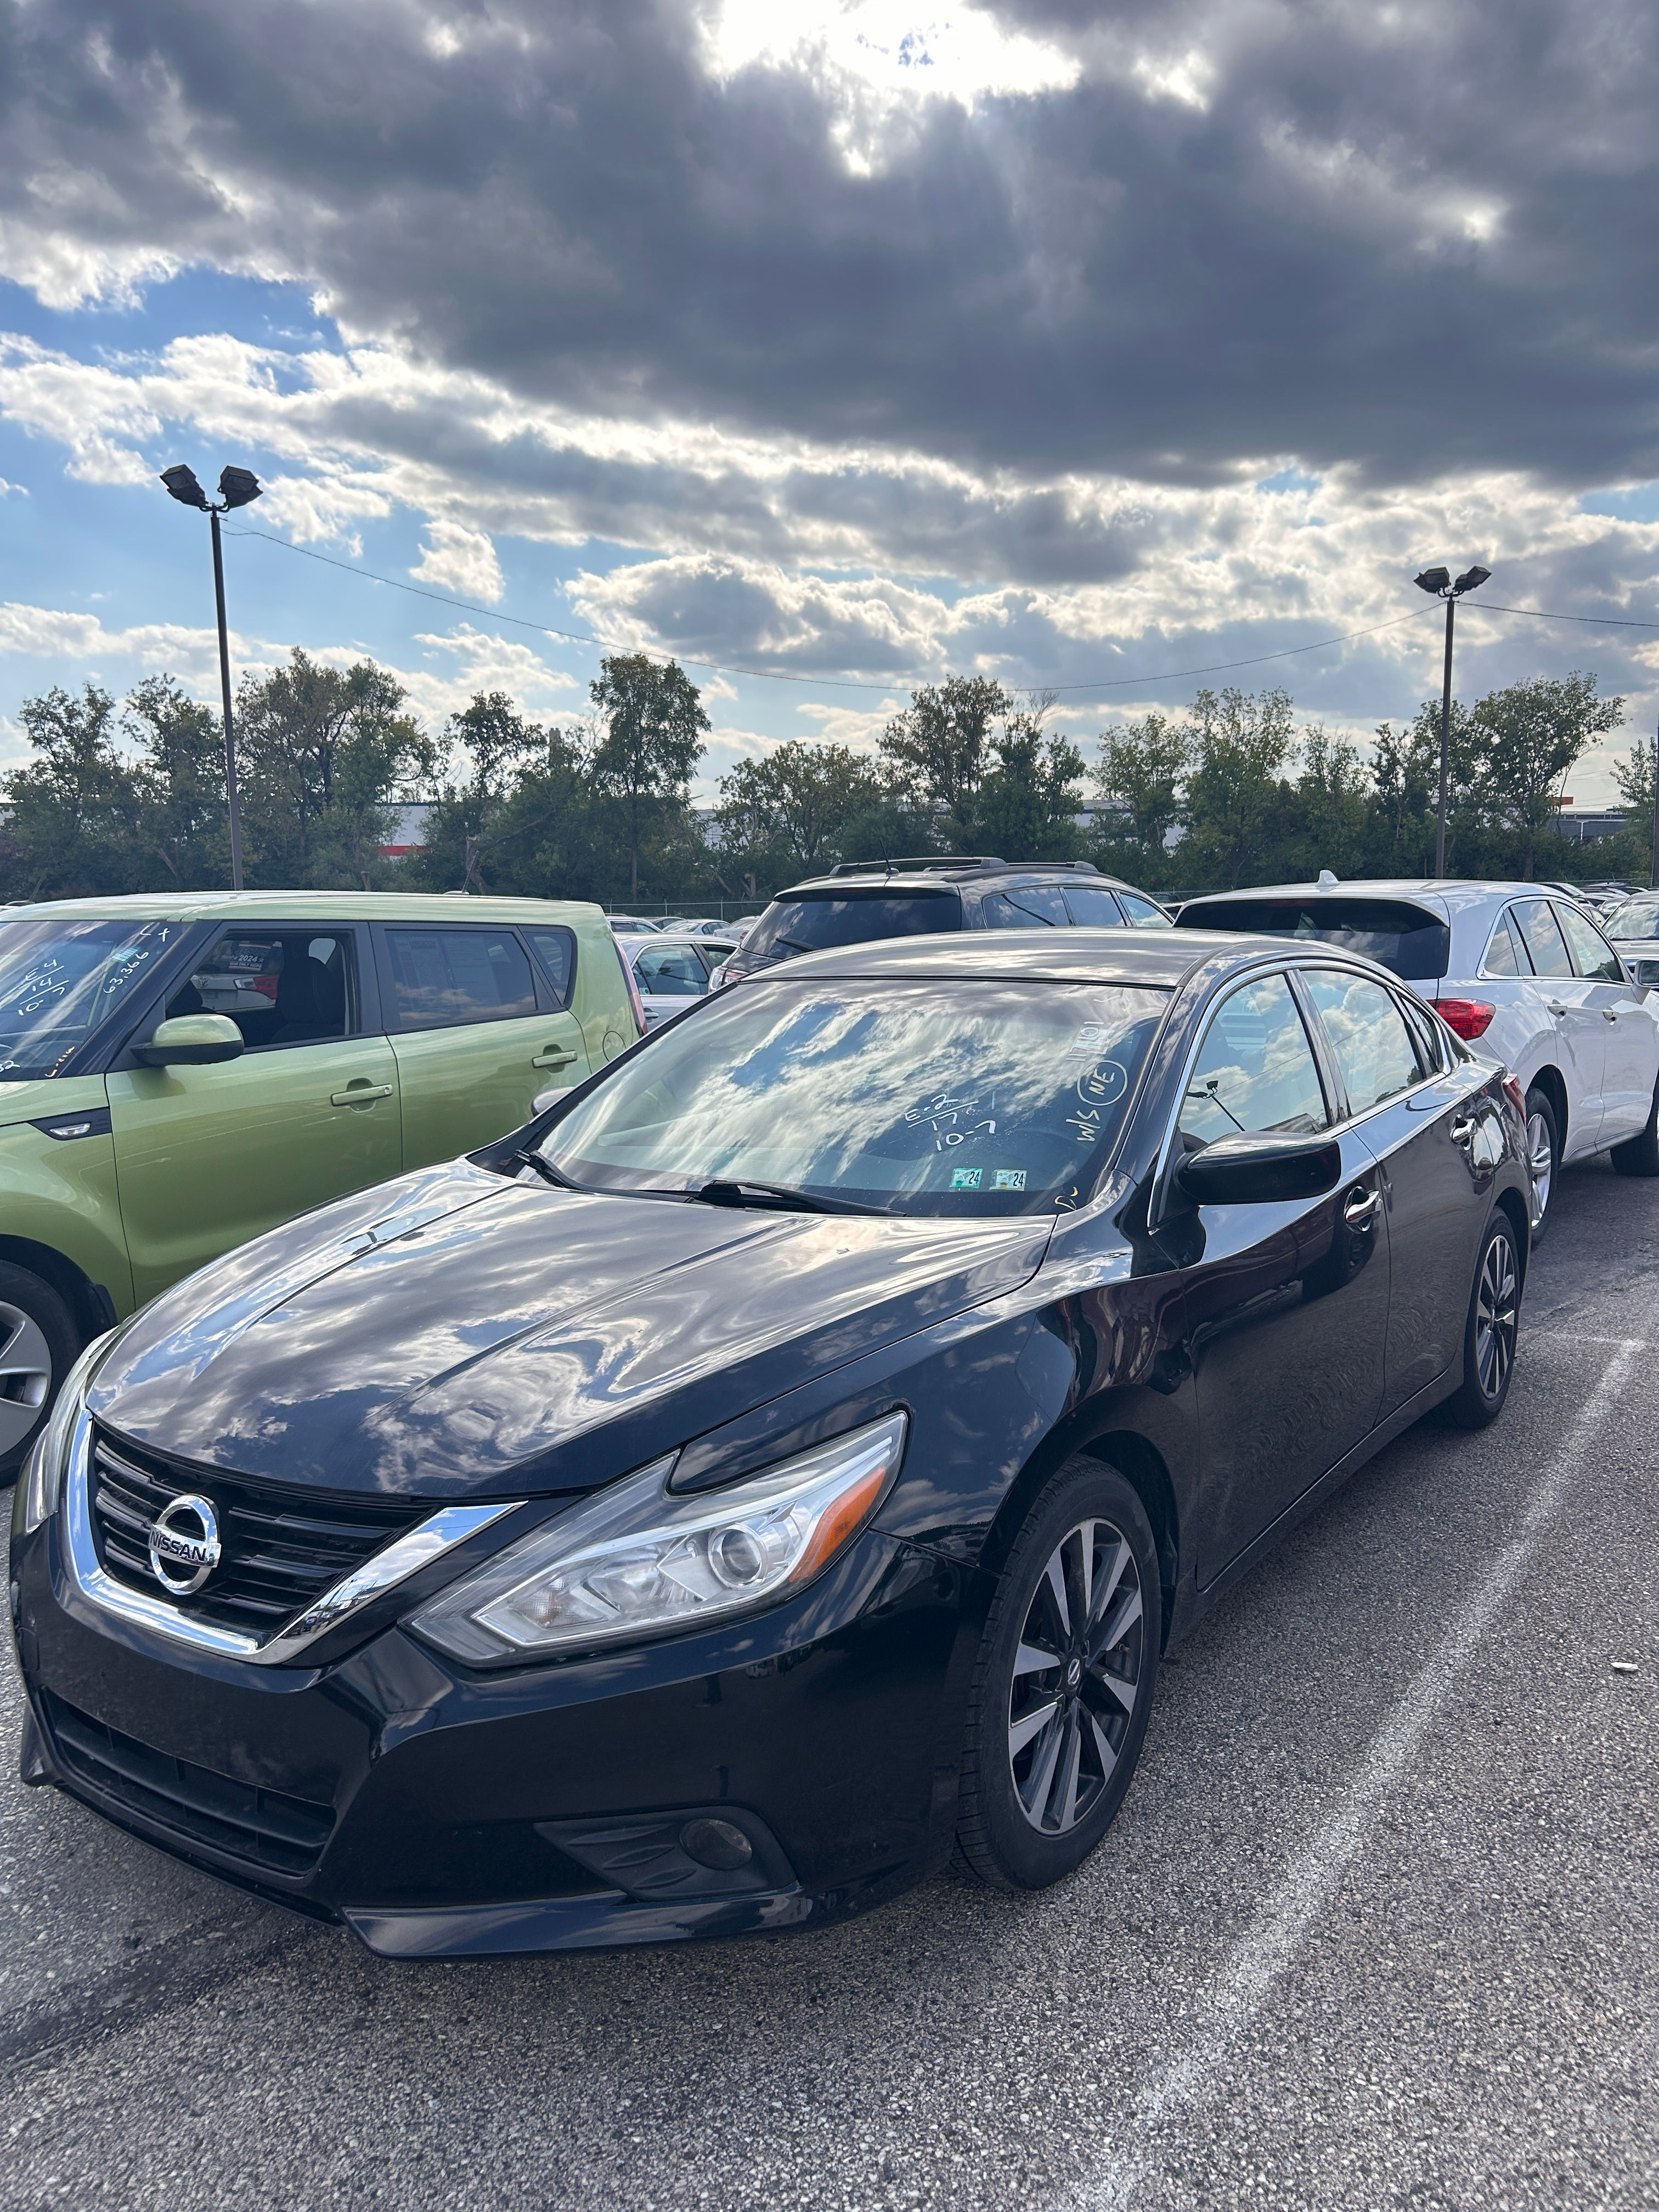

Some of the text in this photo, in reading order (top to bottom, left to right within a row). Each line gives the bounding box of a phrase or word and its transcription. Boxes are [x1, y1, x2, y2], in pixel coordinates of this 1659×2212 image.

[1088, 1069, 1115, 1096] NE
[936, 1119, 996, 1152] 10-7
[968, 1171, 981, 1185] 24
[1012, 1172, 1025, 1187] 24
[150, 1530, 206, 1561] NISSAN
